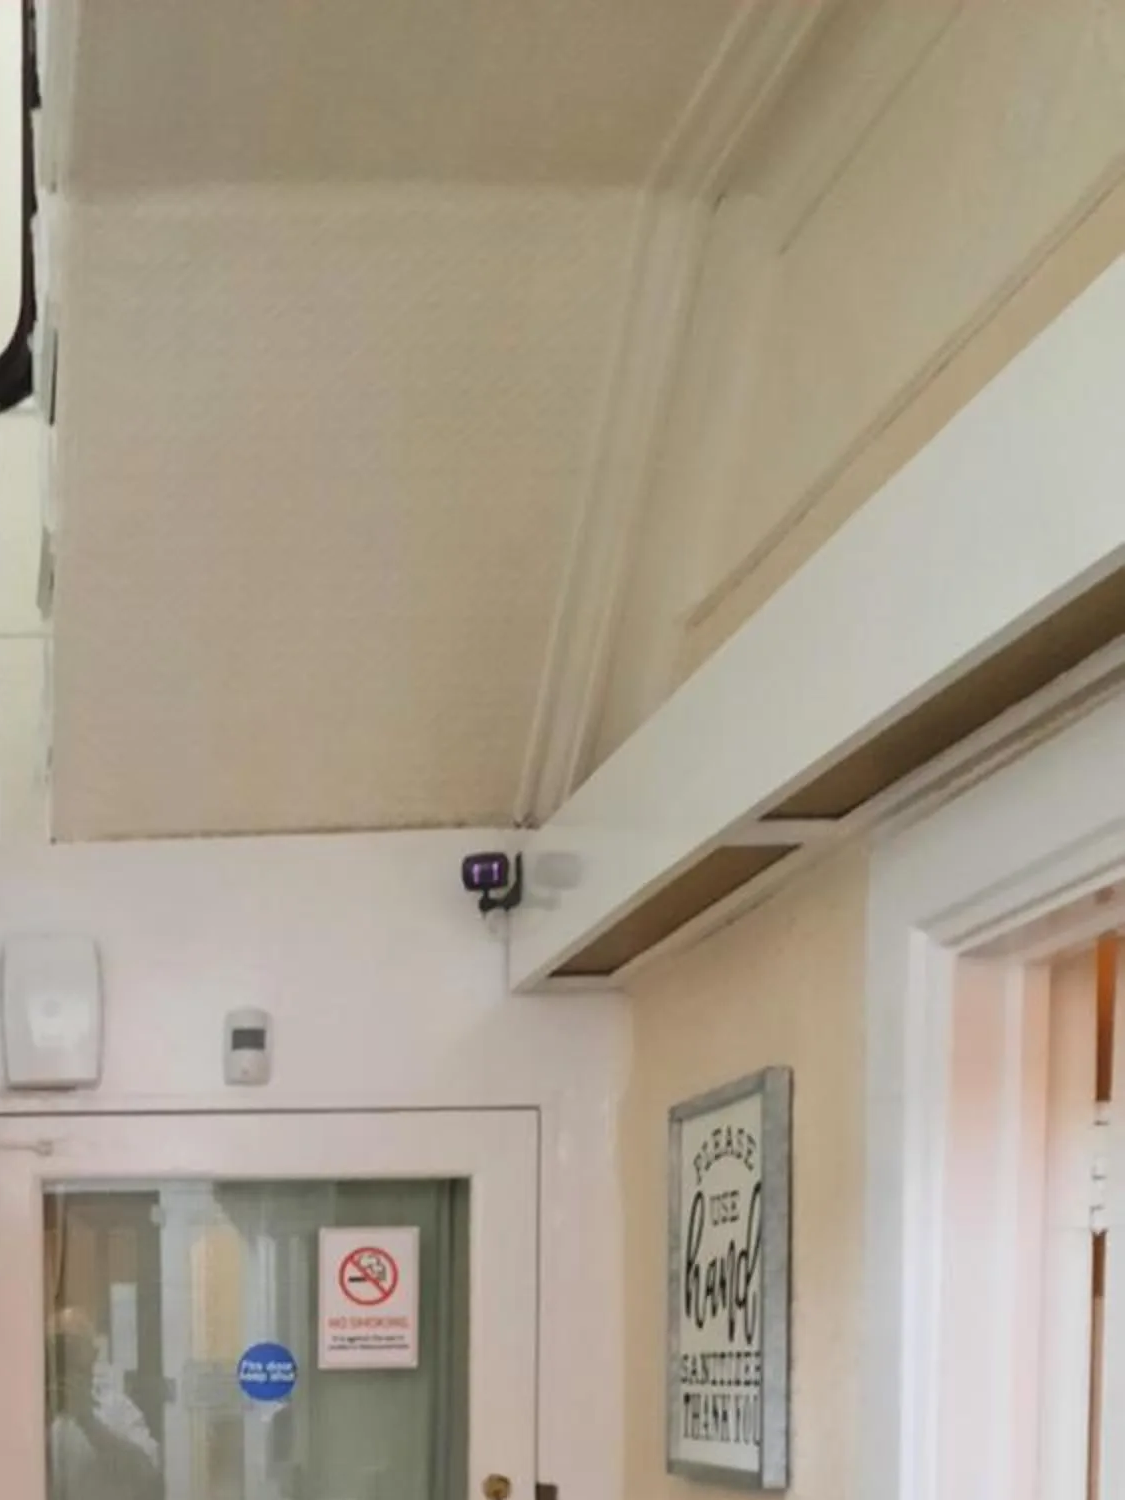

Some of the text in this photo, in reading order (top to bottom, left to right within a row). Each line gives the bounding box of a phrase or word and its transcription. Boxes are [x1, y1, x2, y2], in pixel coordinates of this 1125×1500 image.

[692, 1124, 757, 1186] PLEASE
[709, 1189, 740, 1227] USE
[684, 1181, 762, 1345] hand
[328, 1316, 410, 1330] NO SMOKING
[239, 1370, 295, 1384] keep shut
[241, 1359, 292, 1372] Fire door
[683, 1391, 732, 1442] THANK
